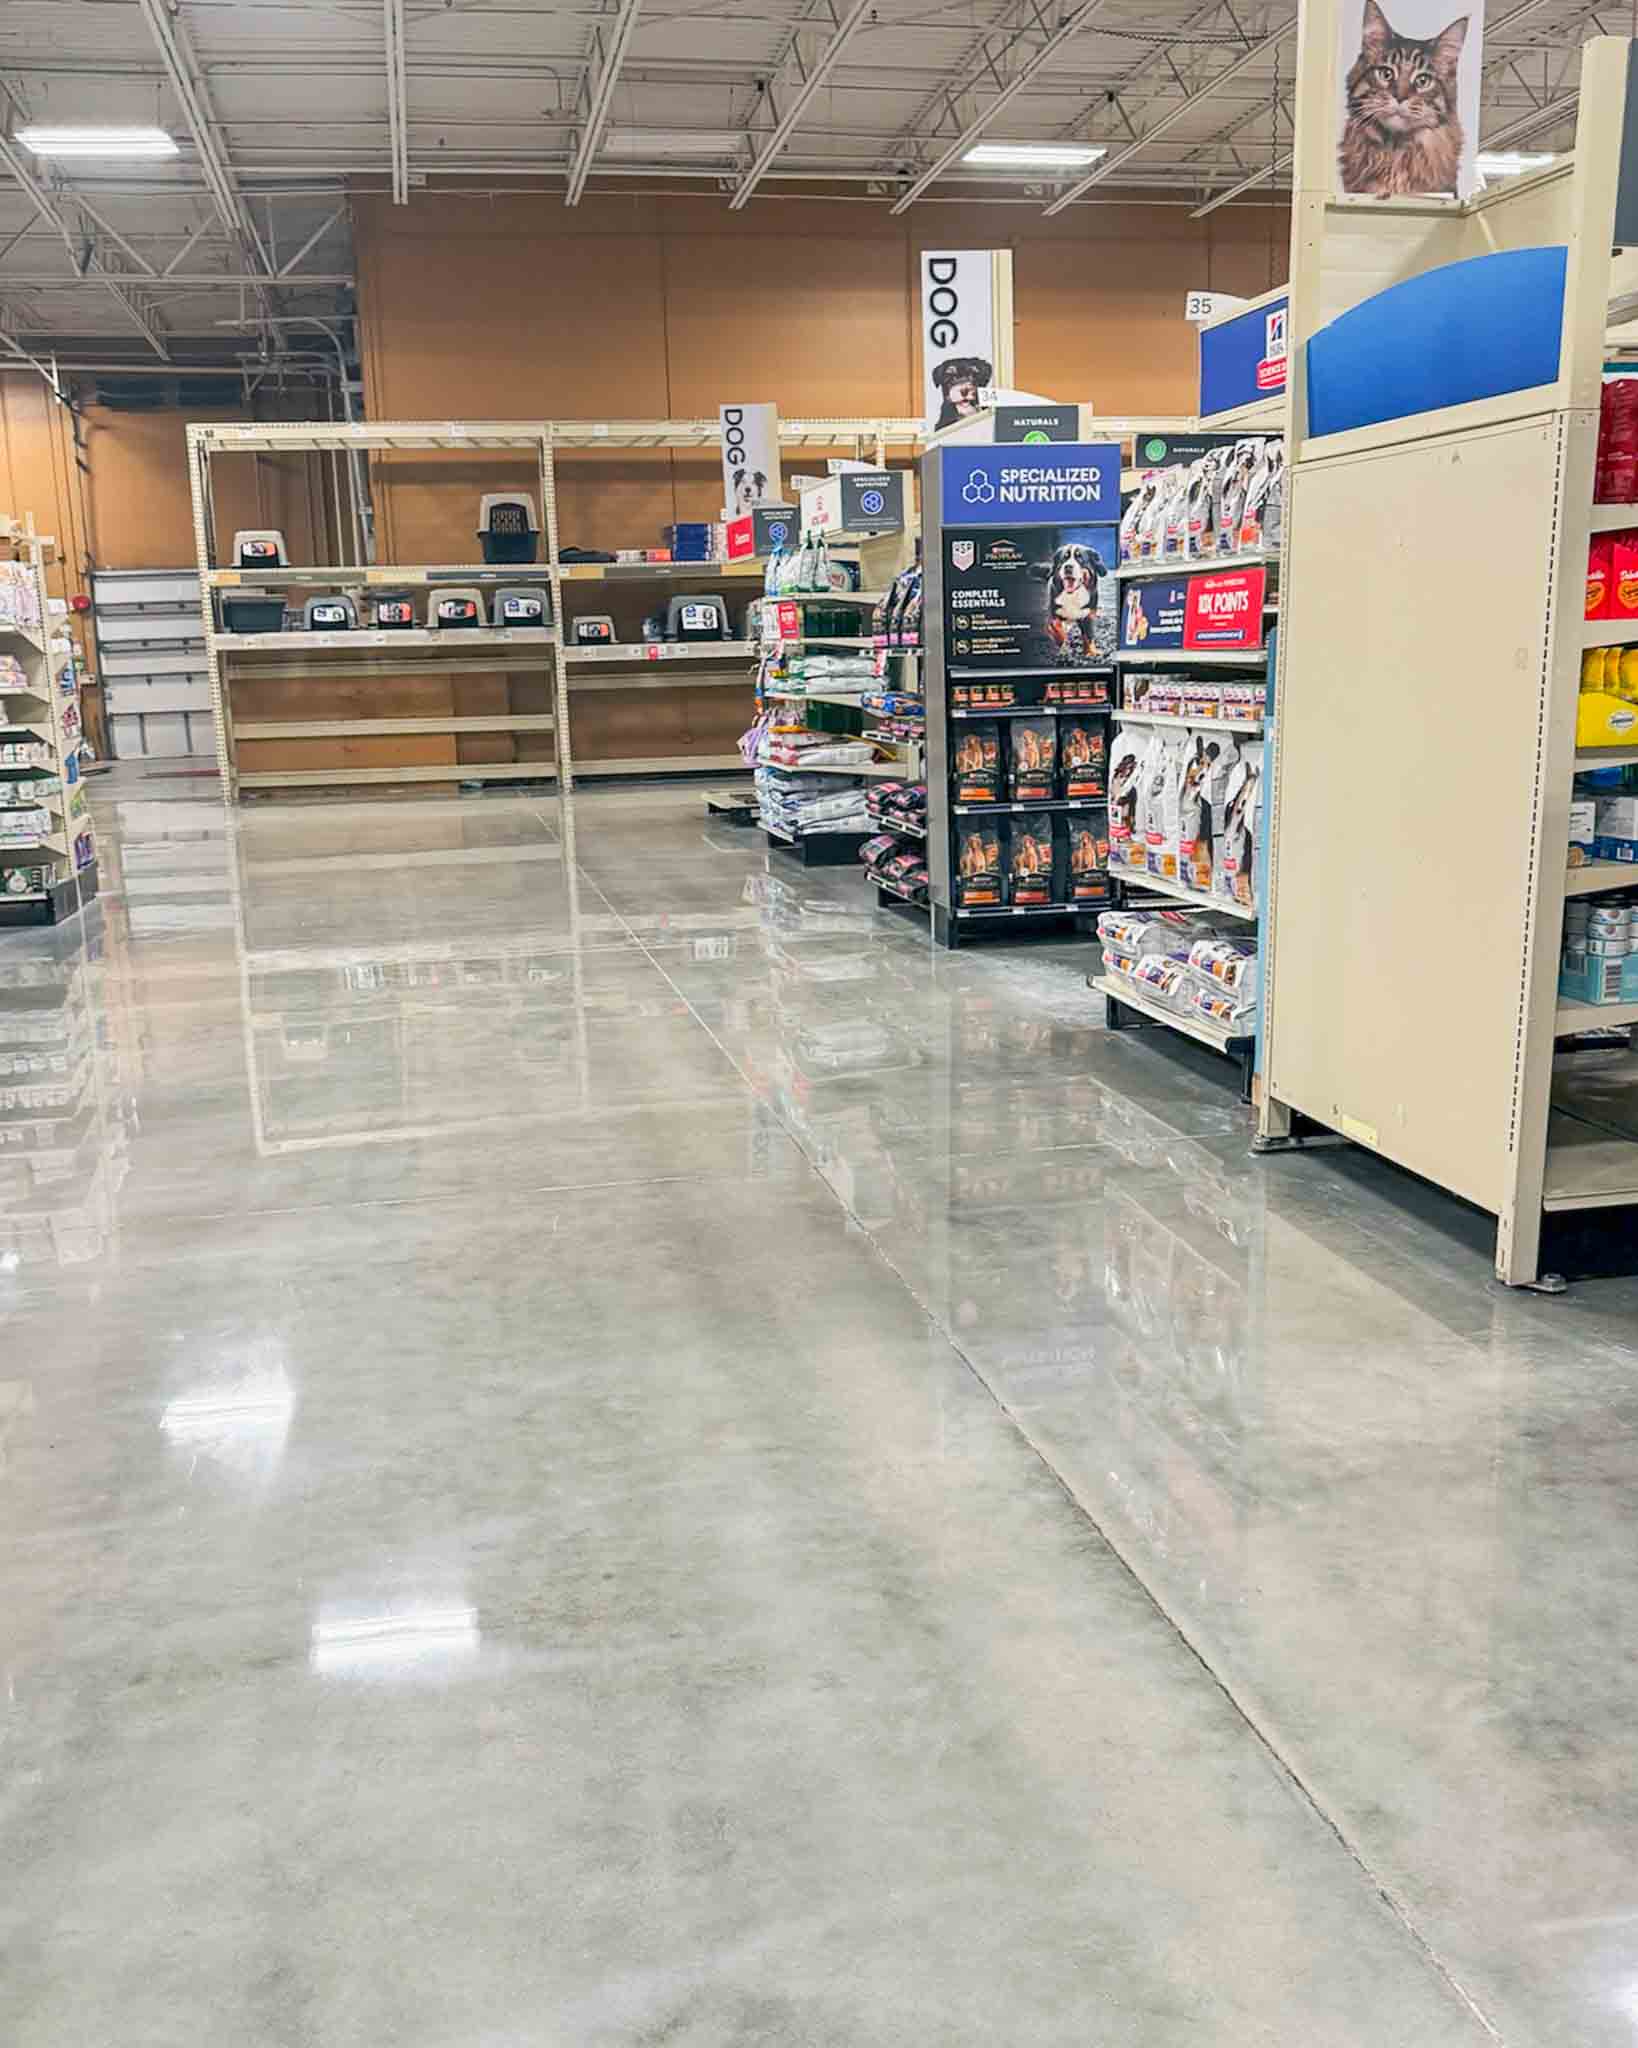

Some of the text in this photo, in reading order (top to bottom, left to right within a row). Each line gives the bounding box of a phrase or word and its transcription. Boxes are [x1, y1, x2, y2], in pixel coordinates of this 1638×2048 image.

[928, 257, 959, 349] DOG
[1189, 297, 1212, 315] 35
[1013, 417, 1059, 427] NATURALS
[724, 409, 745, 465] DOG
[1000, 467, 1101, 484] SPECIALIZED
[999, 484, 1101, 503] NUTRITION
[951, 589, 1000, 600] COMPLETE
[951, 598, 1006, 609] ESSENTIALS
[1213, 589, 1249, 613] POINTS
